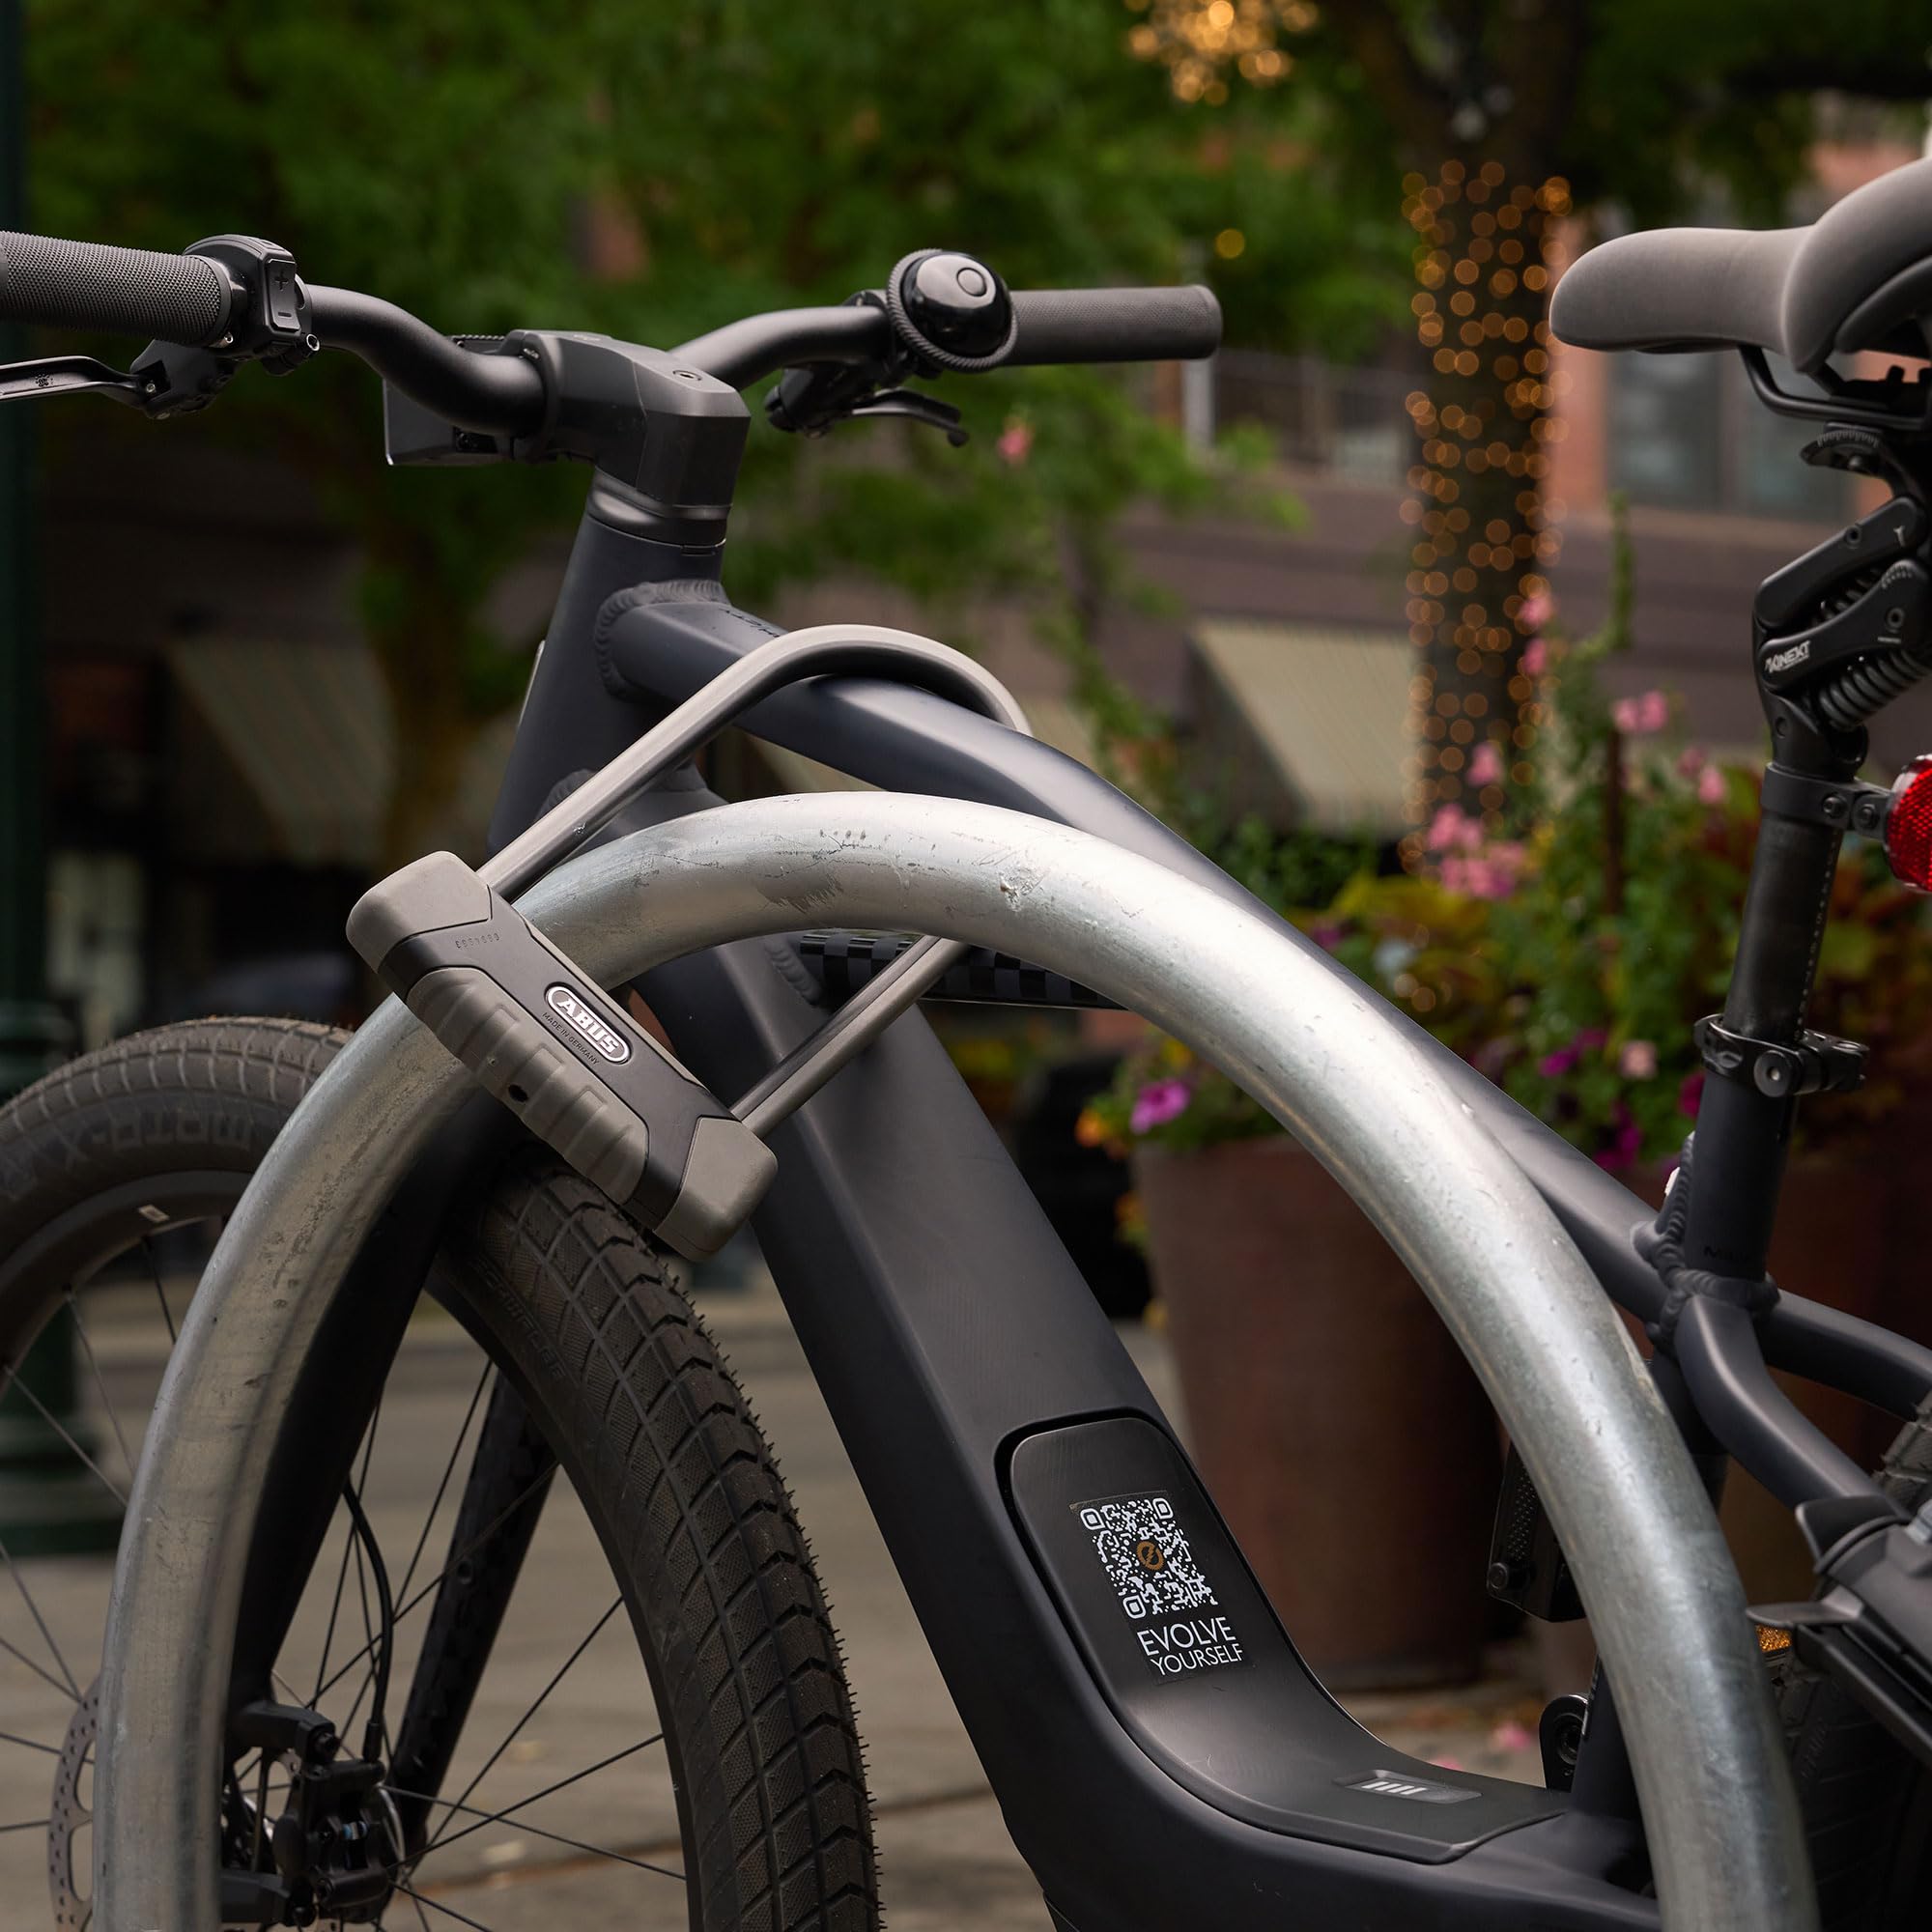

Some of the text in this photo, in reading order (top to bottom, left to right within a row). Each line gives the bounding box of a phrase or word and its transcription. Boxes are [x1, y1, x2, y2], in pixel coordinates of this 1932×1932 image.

[542, 1011, 600, 1065] MADE IN GERMANY
[556, 997, 619, 1053] ABUS
[1137, 1616, 1236, 1657] EVOLVE
[1150, 1643, 1243, 1676] YOURSELF
